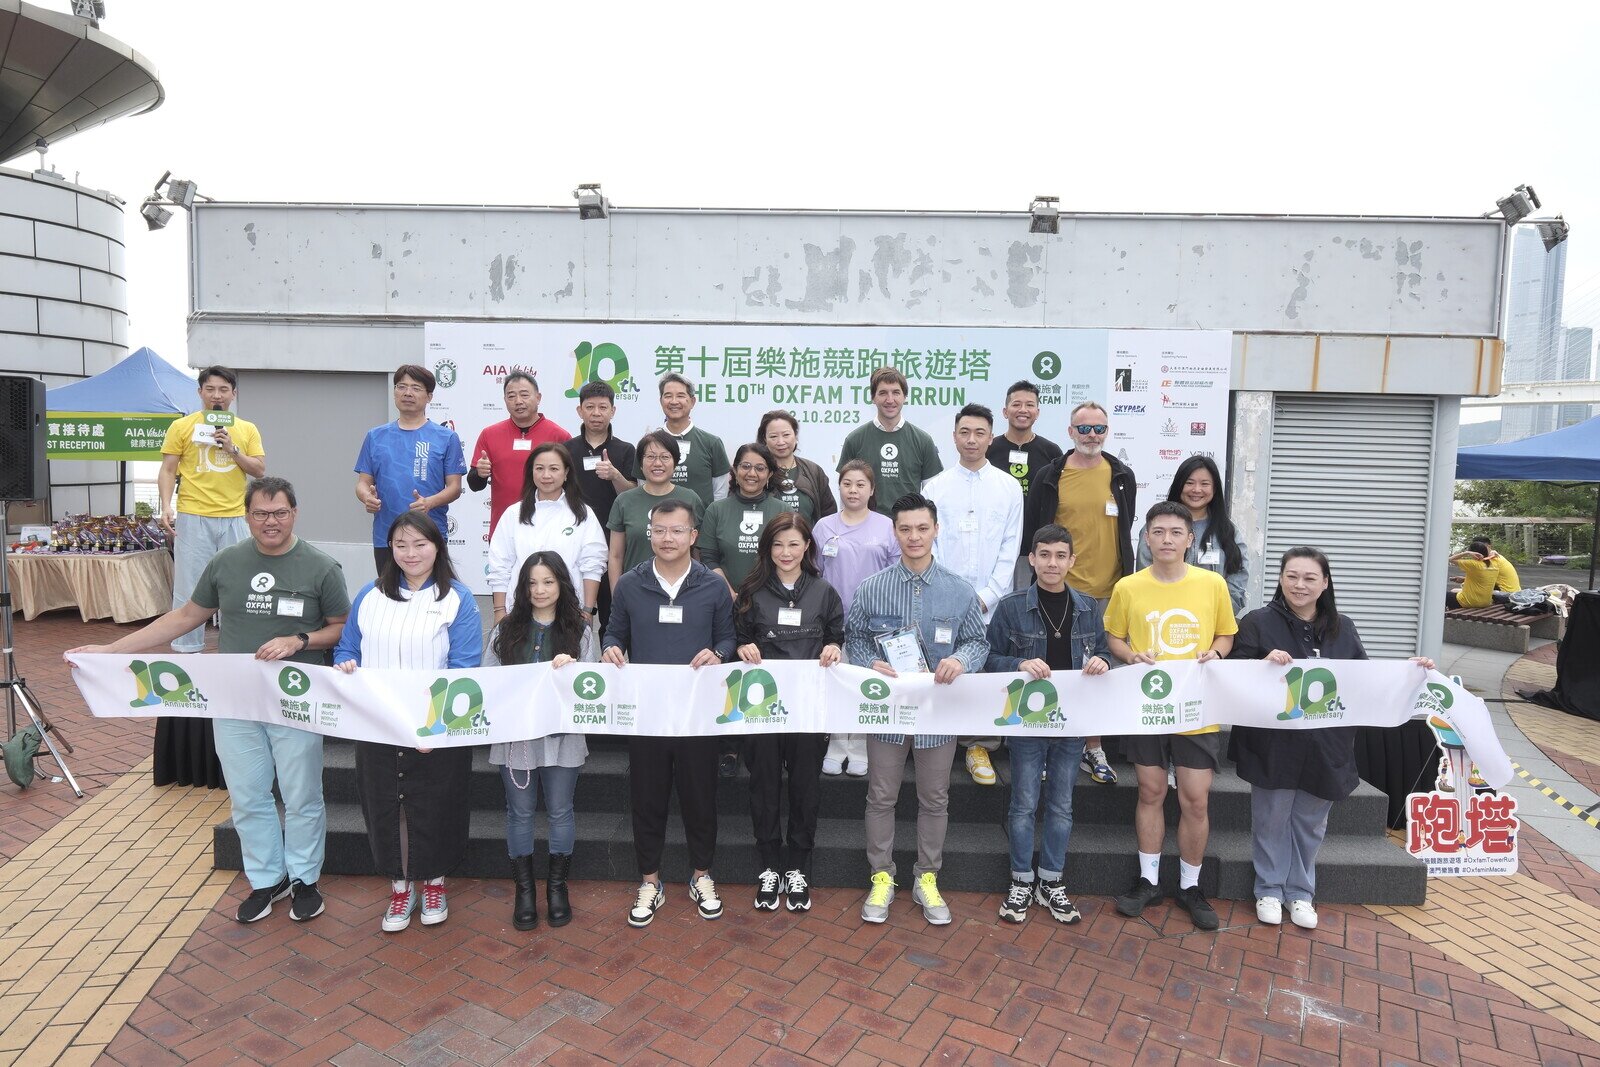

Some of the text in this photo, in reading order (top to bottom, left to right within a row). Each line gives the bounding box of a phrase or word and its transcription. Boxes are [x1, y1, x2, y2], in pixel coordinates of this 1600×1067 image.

[483, 364, 508, 376] AIA
[615, 392, 640, 402] ersary
[694, 383, 717, 403] HE
[772, 384, 843, 405] OXFAM
[850, 385, 966, 406] TOERRUN
[1038, 395, 1062, 405] XFAM
[790, 409, 860, 424] 2.10.2023
[125, 428, 145, 437] AIA
[59, 440, 105, 450] RECEPTION
[738, 541, 759, 549] OXFAM
[245, 601, 272, 610] OXFAM
[164, 698, 208, 711] Anniversary
[280, 698, 311, 713] 樂施會
[573, 703, 607, 714] 樂施會
[859, 702, 890, 714] 樂施會
[1141, 702, 1175, 714] 樂施會
[281, 709, 311, 724] OXFAM
[573, 714, 607, 725] OXFAM
[744, 715, 788, 725] Anniversary
[858, 714, 889, 725] OXFAM
[1141, 715, 1175, 726] OXFAM
[1303, 710, 1345, 721] Anniversary
[1022, 719, 1066, 731] Anniversary
[446, 726, 490, 737] Anniversary
[1409, 793, 1516, 855] 跑塔
[1463, 856, 1515, 864] #OxfamTowerRun
[1462, 866, 1507, 874] #OxfaminMacau
